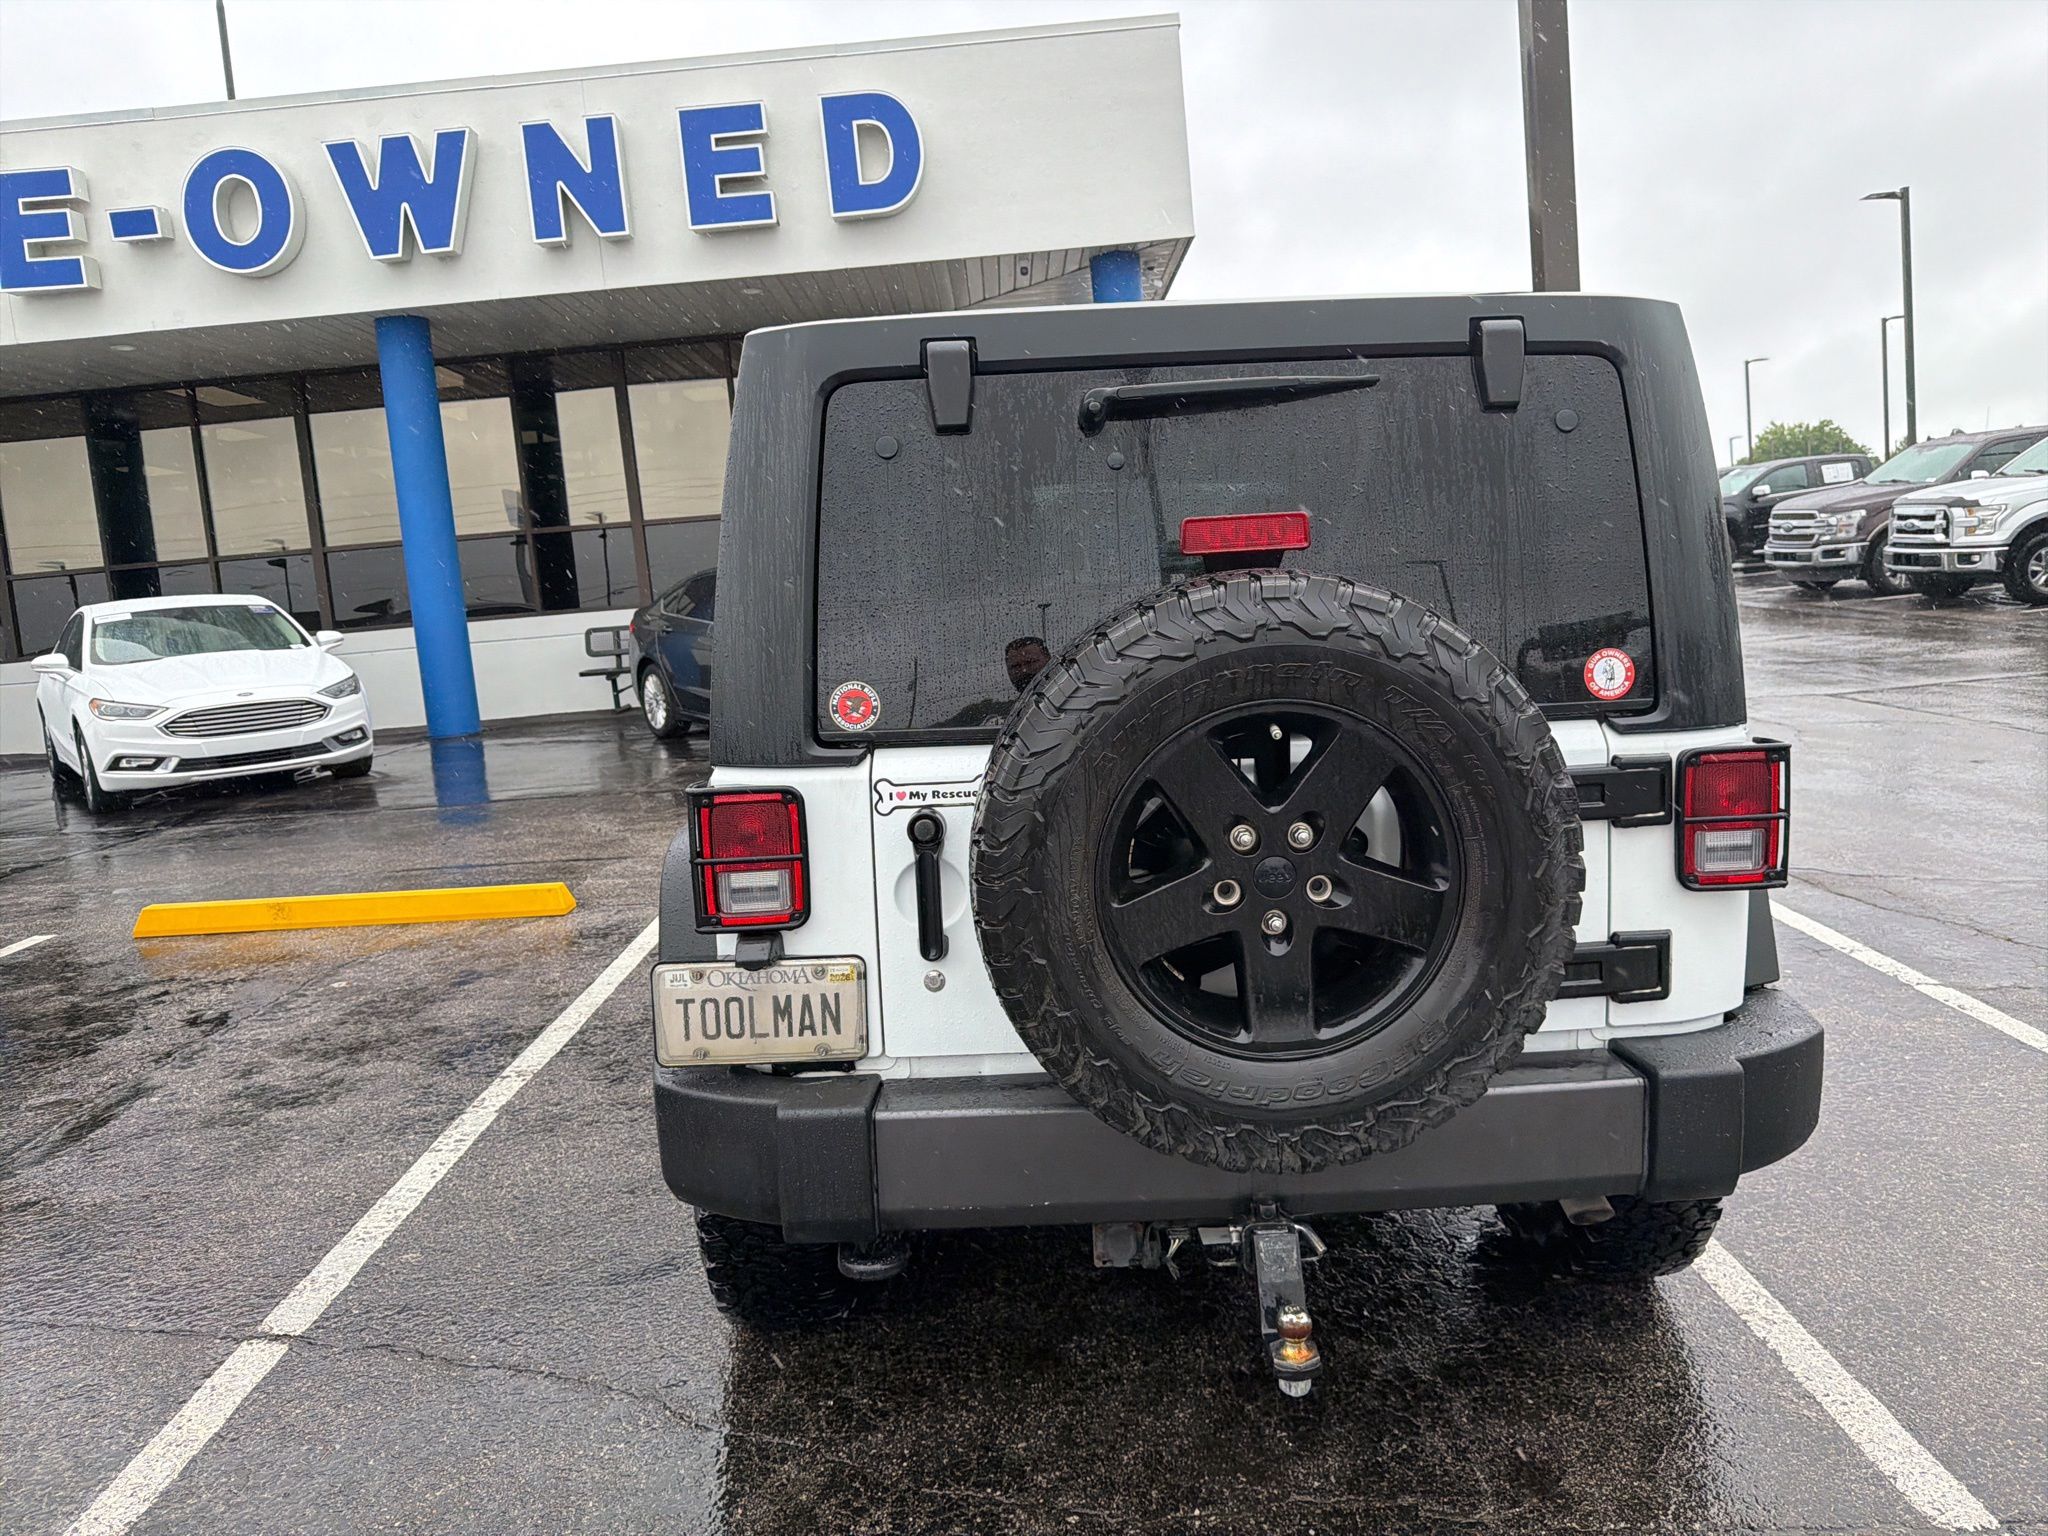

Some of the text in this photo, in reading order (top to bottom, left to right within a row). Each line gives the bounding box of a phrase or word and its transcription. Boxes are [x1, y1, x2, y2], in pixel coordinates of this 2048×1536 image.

[1588, 650, 1630, 669] GUN OWNERS
[832, 683, 878, 706] NATIONAL RIFLE
[1589, 681, 1630, 697] OF AMERICA
[833, 713, 875, 730] ASSOCIATION
[889, 792, 893, 801] I
[909, 791, 928, 801] My
[670, 973, 687, 983] JUL
[707, 966, 812, 991] OKLAHOMA
[675, 992, 842, 1042] TOOLMAN
